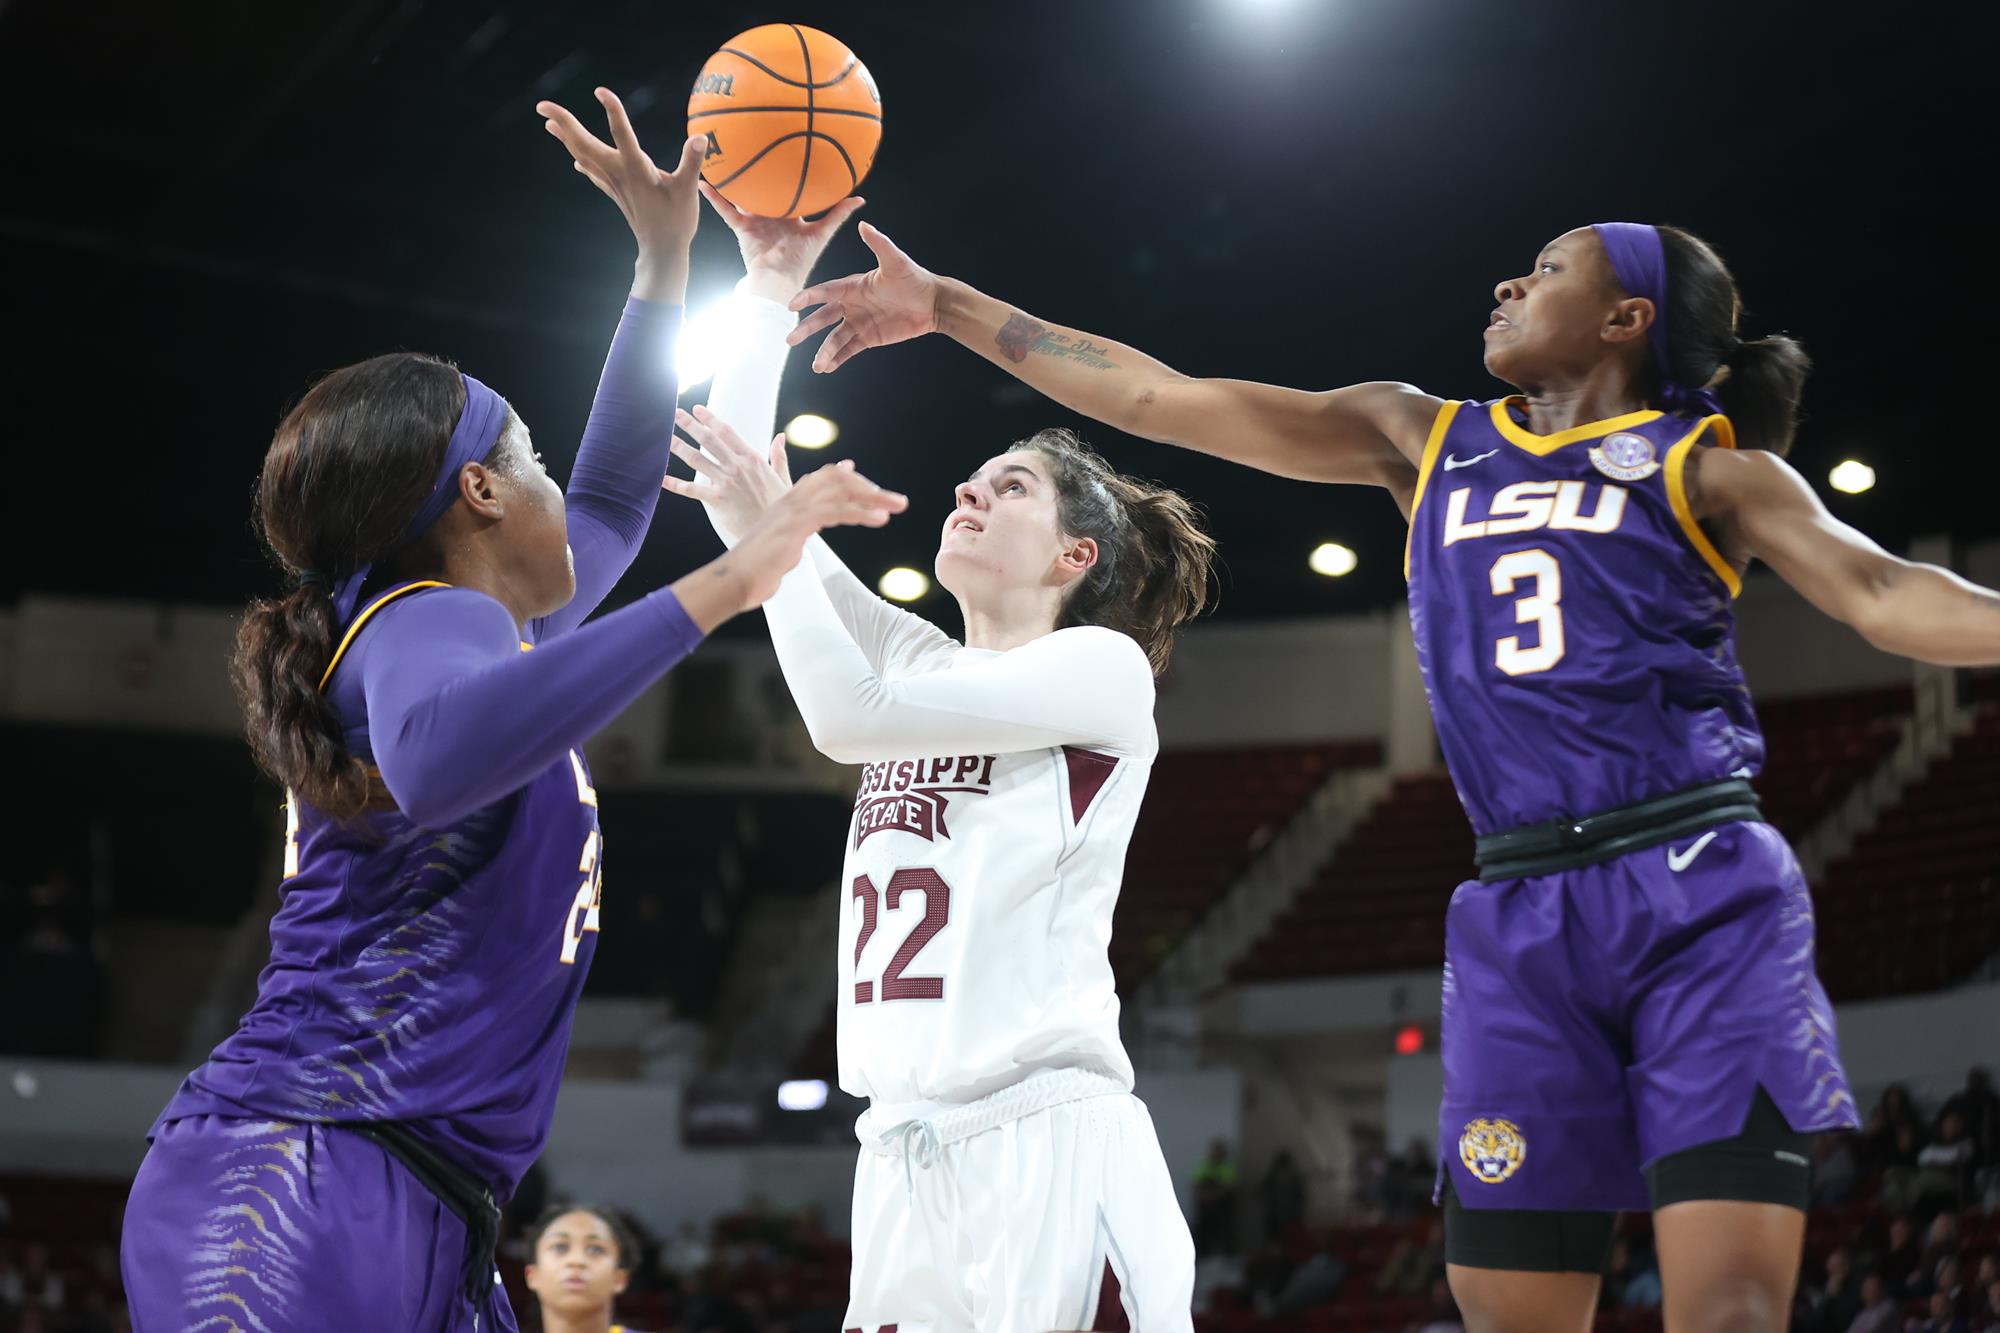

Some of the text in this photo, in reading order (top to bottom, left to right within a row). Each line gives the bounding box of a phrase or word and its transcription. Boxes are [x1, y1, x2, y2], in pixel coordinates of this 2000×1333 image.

[1443, 480, 1628, 547] LSU
[1489, 549, 1565, 676] 3
[859, 802, 922, 837] STATE
[852, 867, 951, 1004] 22
